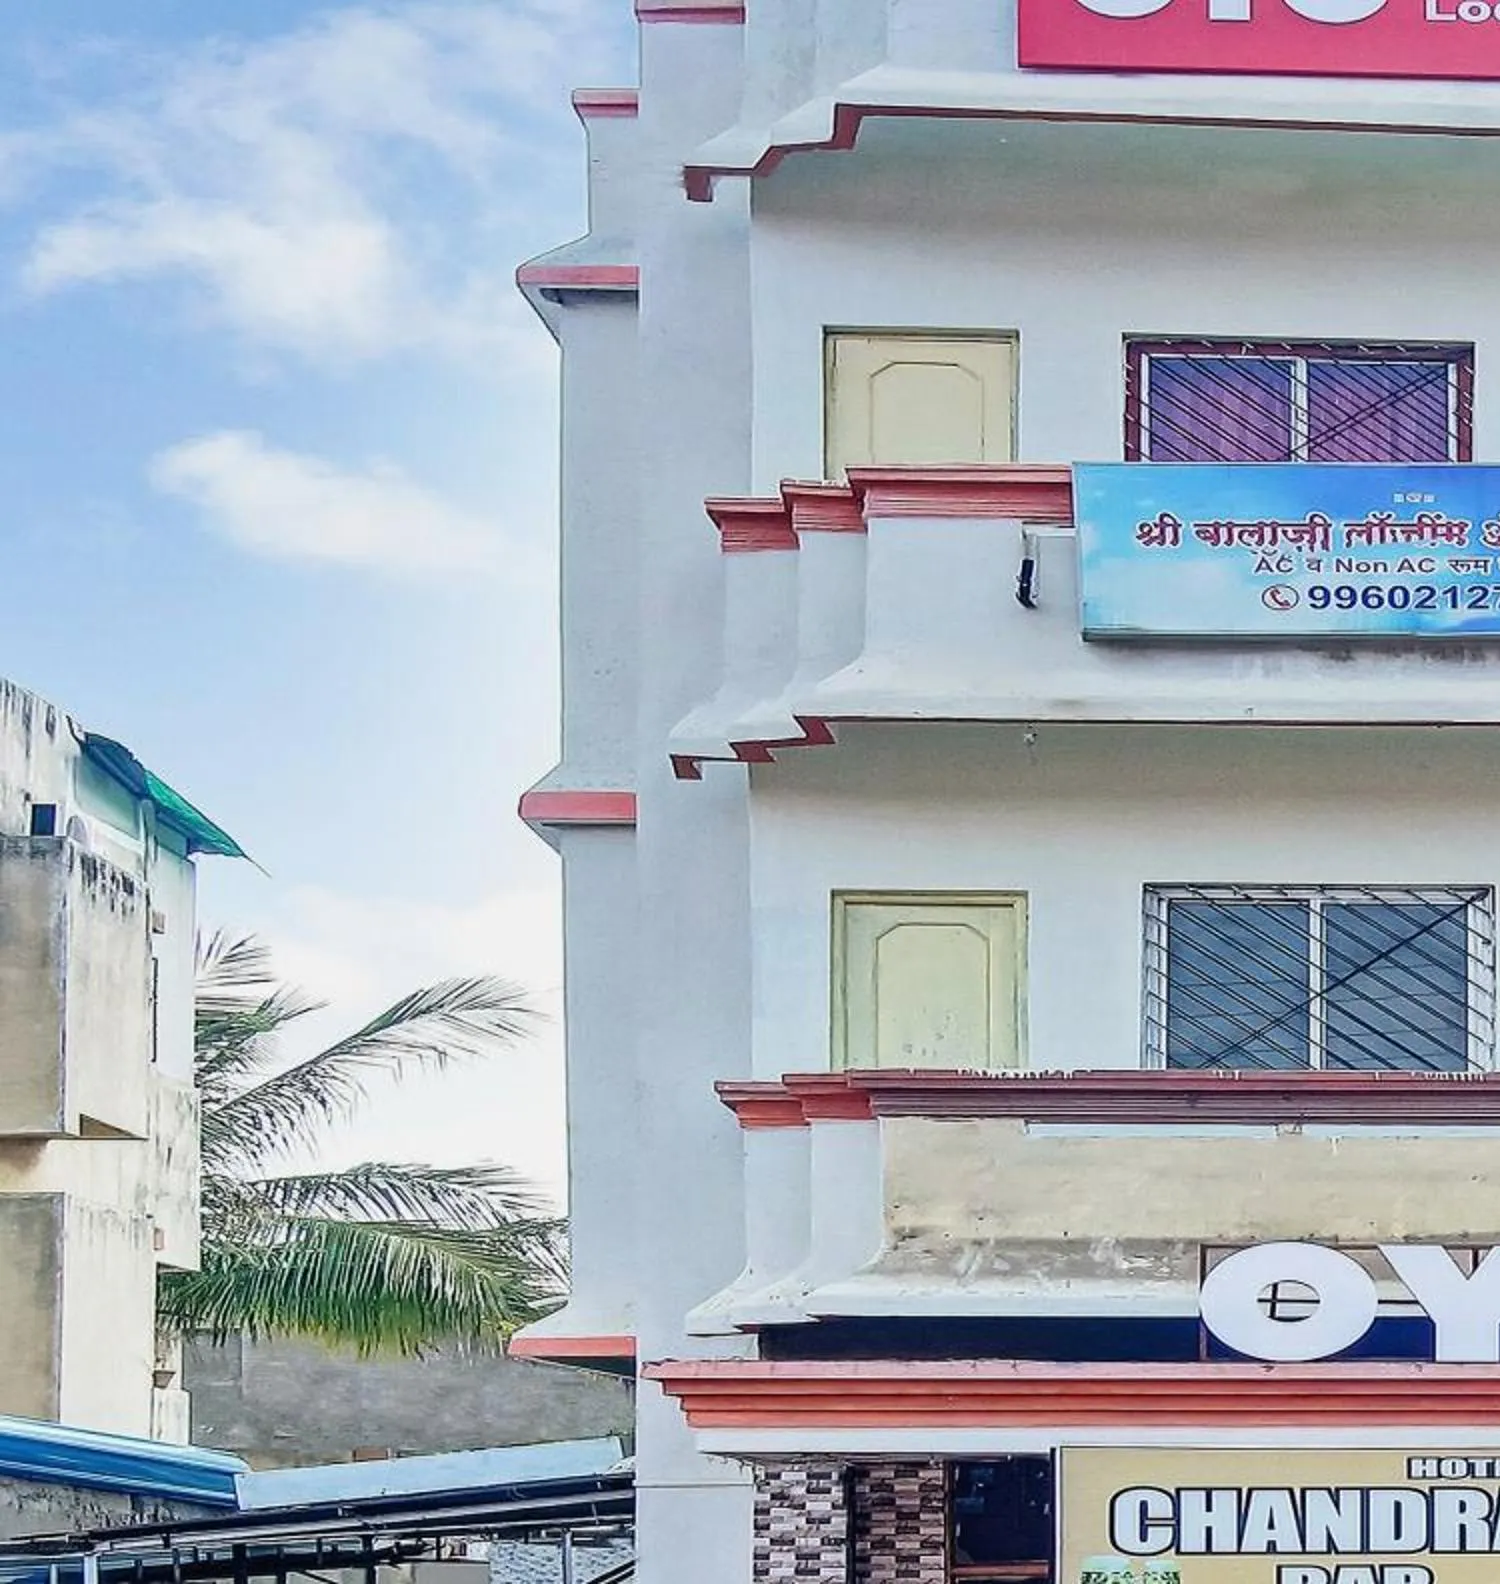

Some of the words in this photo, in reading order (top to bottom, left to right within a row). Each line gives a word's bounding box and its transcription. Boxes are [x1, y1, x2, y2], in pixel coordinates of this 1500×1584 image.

[1136, 513, 1181, 547] श्री
[1307, 558, 1321, 573] व
[1335, 558, 1388, 573] Non
[1397, 558, 1436, 573] AC
[1449, 558, 1489, 575] रूम
